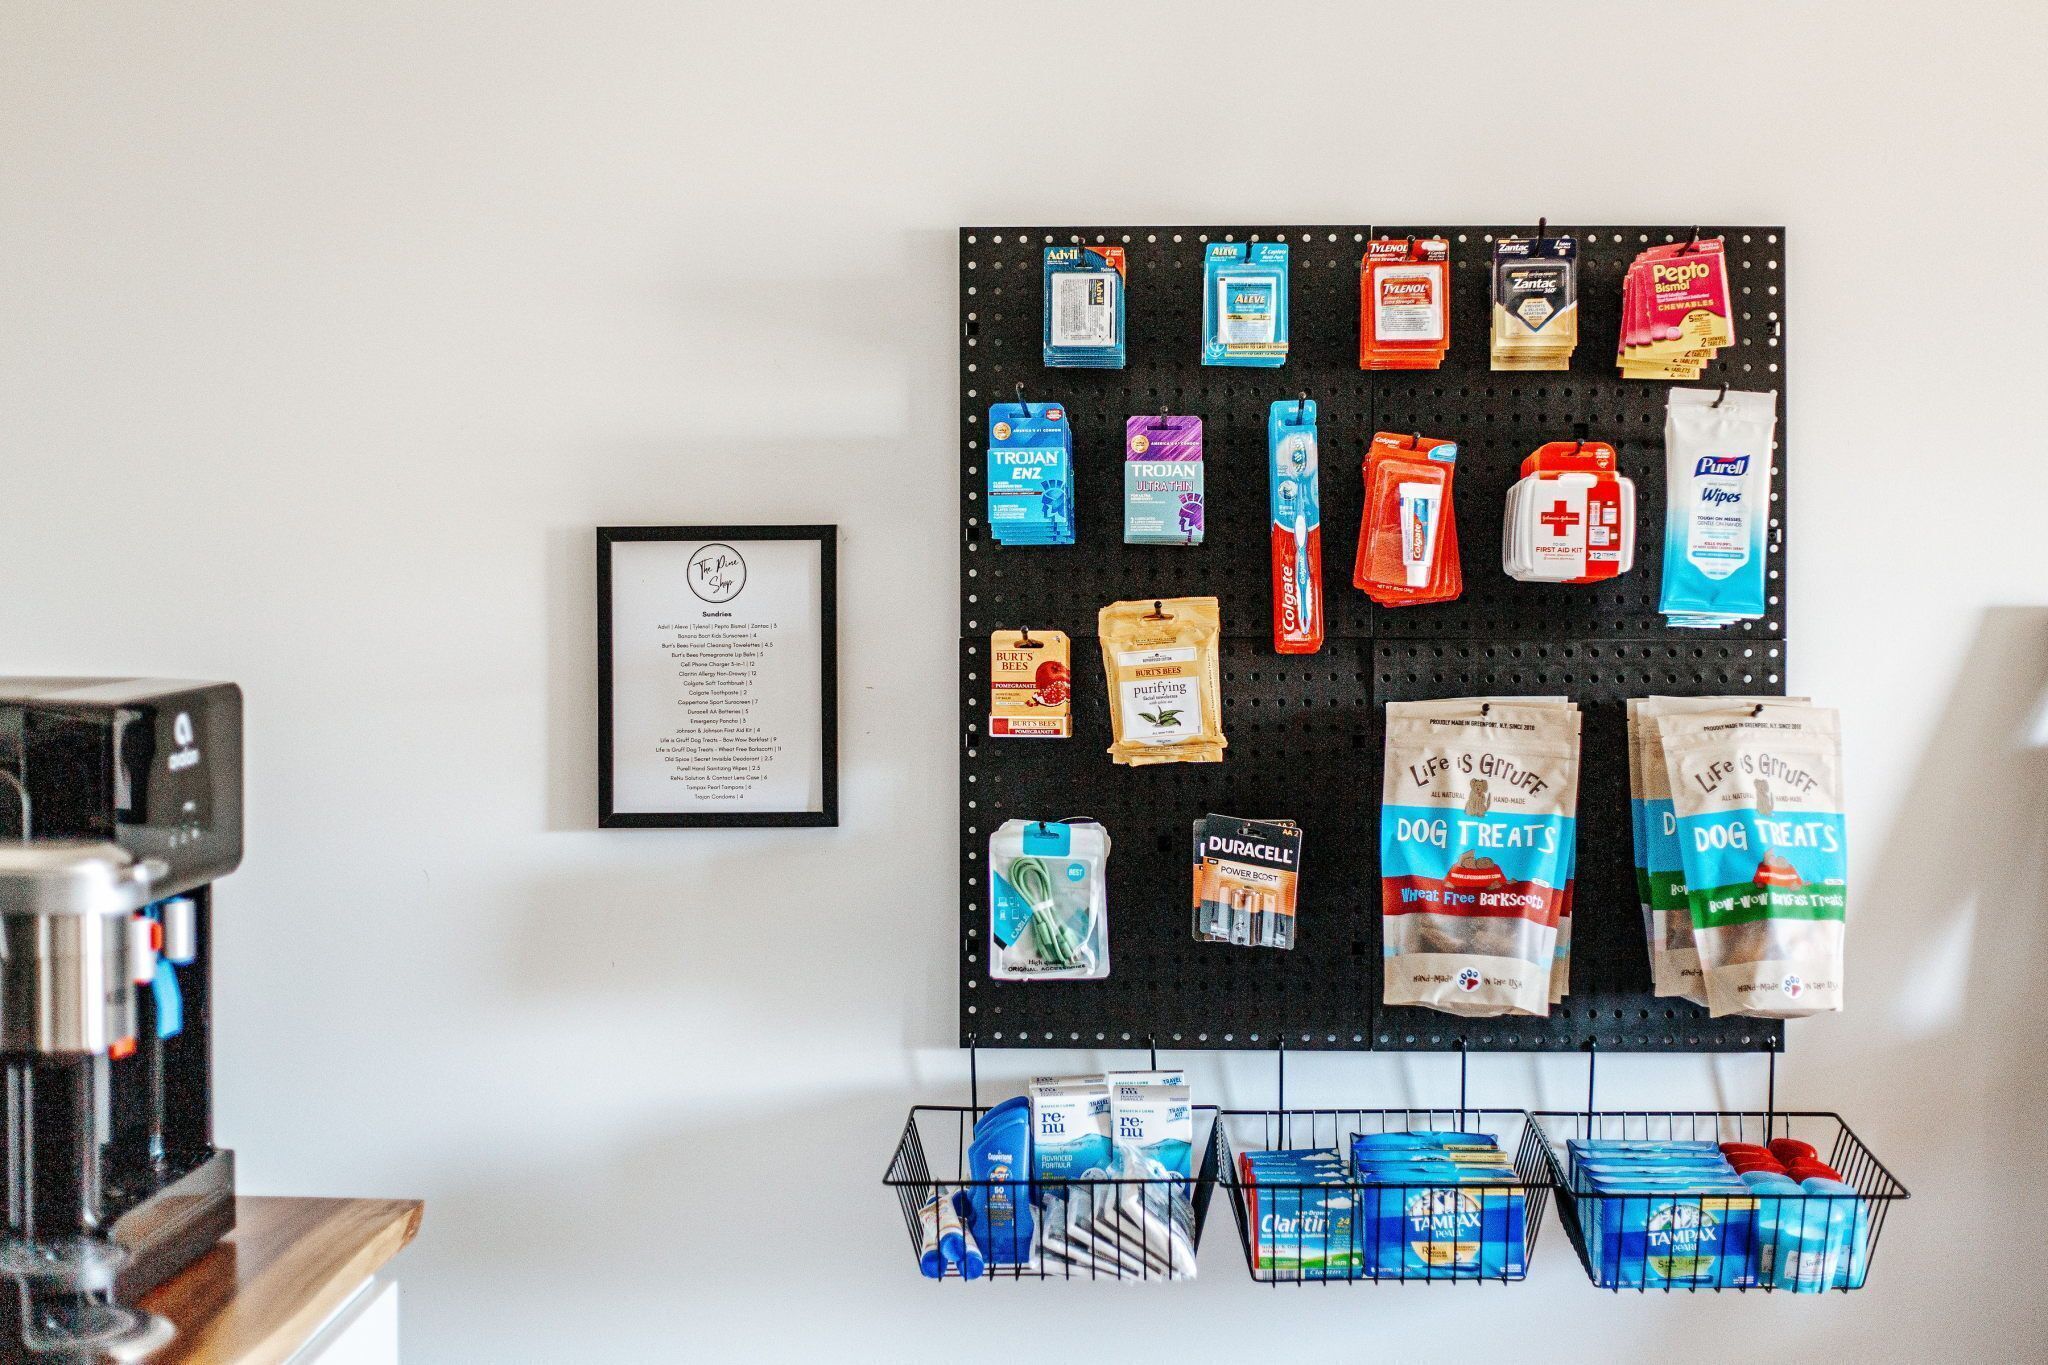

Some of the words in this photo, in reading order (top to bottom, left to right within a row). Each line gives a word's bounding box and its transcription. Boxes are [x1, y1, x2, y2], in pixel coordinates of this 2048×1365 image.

[1260, 246, 1268, 255] 2
[1498, 243, 1529, 252] Zantac
[1047, 249, 1077, 260] Advil
[1652, 261, 1710, 284] Pepto
[1383, 284, 1426, 295] TYLENOL
[1513, 278, 1557, 289] Zantac
[1655, 280, 1690, 294] Bismol
[1234, 294, 1266, 304] ALEVE
[1658, 299, 1714, 312] CHEWABLES
[1375, 436, 1401, 445] Colgate
[993, 451, 1058, 465] TROJAN
[1131, 464, 1195, 477] TROJAN
[1700, 457, 1745, 475] Purell
[1012, 467, 1042, 479] ENZ
[1136, 480, 1168, 492] ULTRA
[1168, 480, 1193, 492] THIN
[1702, 487, 1742, 507] Wipes
[1413, 523, 1424, 559] Colgate
[1592, 552, 1602, 560] 12
[693, 556, 713, 581] The
[1299, 556, 1307, 585] Colgate
[708, 573, 736, 595] Shop
[1282, 565, 1297, 631] Colgate
[996, 652, 1033, 661] BURT'S
[1002, 661, 1028, 671] BEES
[1135, 668, 1162, 677] BURT'S
[1162, 666, 1181, 675] BEES
[1133, 681, 1187, 698] purifying
[1012, 720, 1037, 728] BURT'S
[1038, 720, 1057, 728] BEES
[1430, 791, 1441, 799] ALL
[1441, 791, 1465, 799] NATURAL
[1493, 796, 1526, 805] HAND-MADE
[1397, 817, 1447, 849] DOG
[1456, 818, 1557, 854] TREATS
[1695, 820, 1748, 852] DOG
[1754, 818, 1838, 852] TREATS
[1209, 835, 1293, 864] DURACELL
[1068, 867, 1083, 876] BEST
[1220, 866, 1252, 879] POWER
[1252, 870, 1278, 883] BOOST
[1443, 891, 1476, 905] Free
[1028, 959, 1043, 967] High
[1162, 1076, 1182, 1084] TRAVEL
[1089, 1099, 1109, 1107] TRAVEL
[1168, 1106, 1189, 1114] TRAVEL
[1041, 1123, 1066, 1134] nu
[1120, 1127, 1145, 1137] nu
[1041, 1155, 1073, 1163] ADVANCED
[1647, 1226, 1717, 1247] TAMPAX
